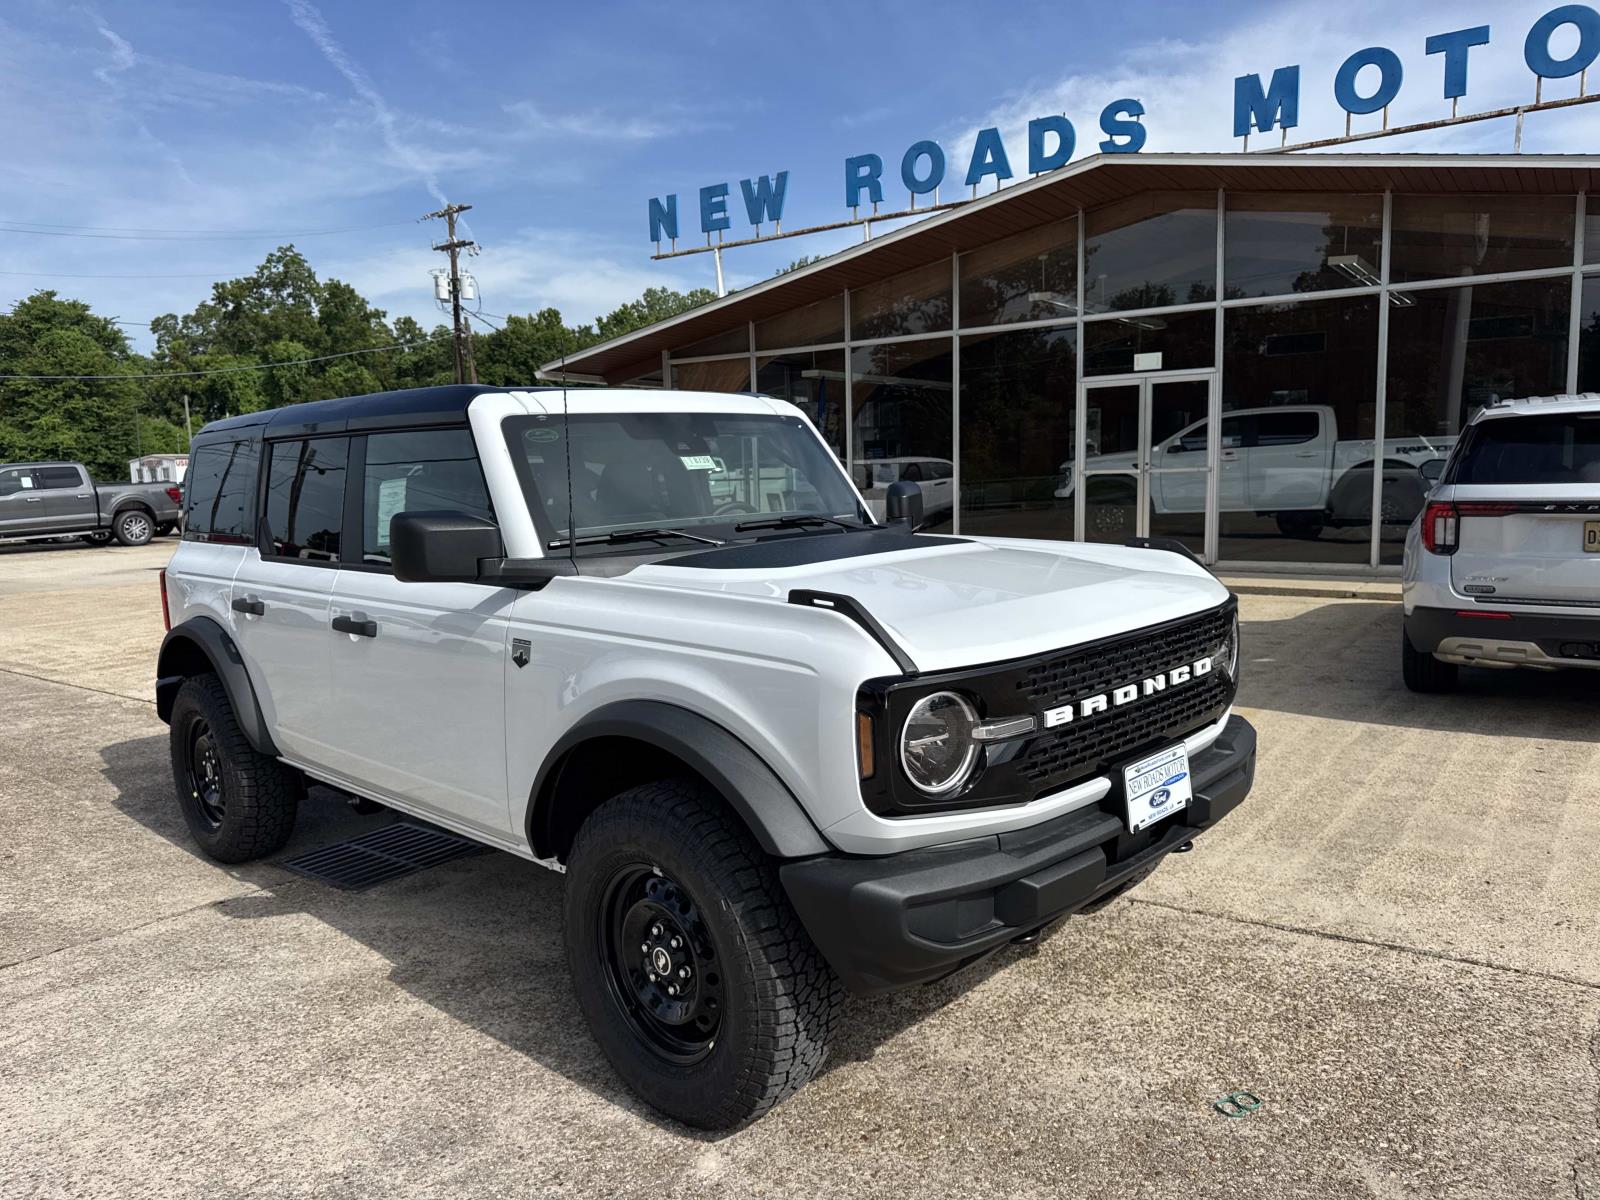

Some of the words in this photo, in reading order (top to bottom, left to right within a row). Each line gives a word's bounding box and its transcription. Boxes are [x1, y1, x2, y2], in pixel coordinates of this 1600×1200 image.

[648, 170, 789, 242] NEW
[845, 98, 1146, 208] ROADS
[1233, 4, 1600, 137] MOTO
[1588, 530, 1600, 544] D
[1043, 657, 1212, 728] BRONCO
[1129, 779, 1143, 796] NEW
[1143, 766, 1163, 789] ROADS
[1163, 758, 1186, 779] MOTOR
[1152, 790, 1168, 806] Ford
